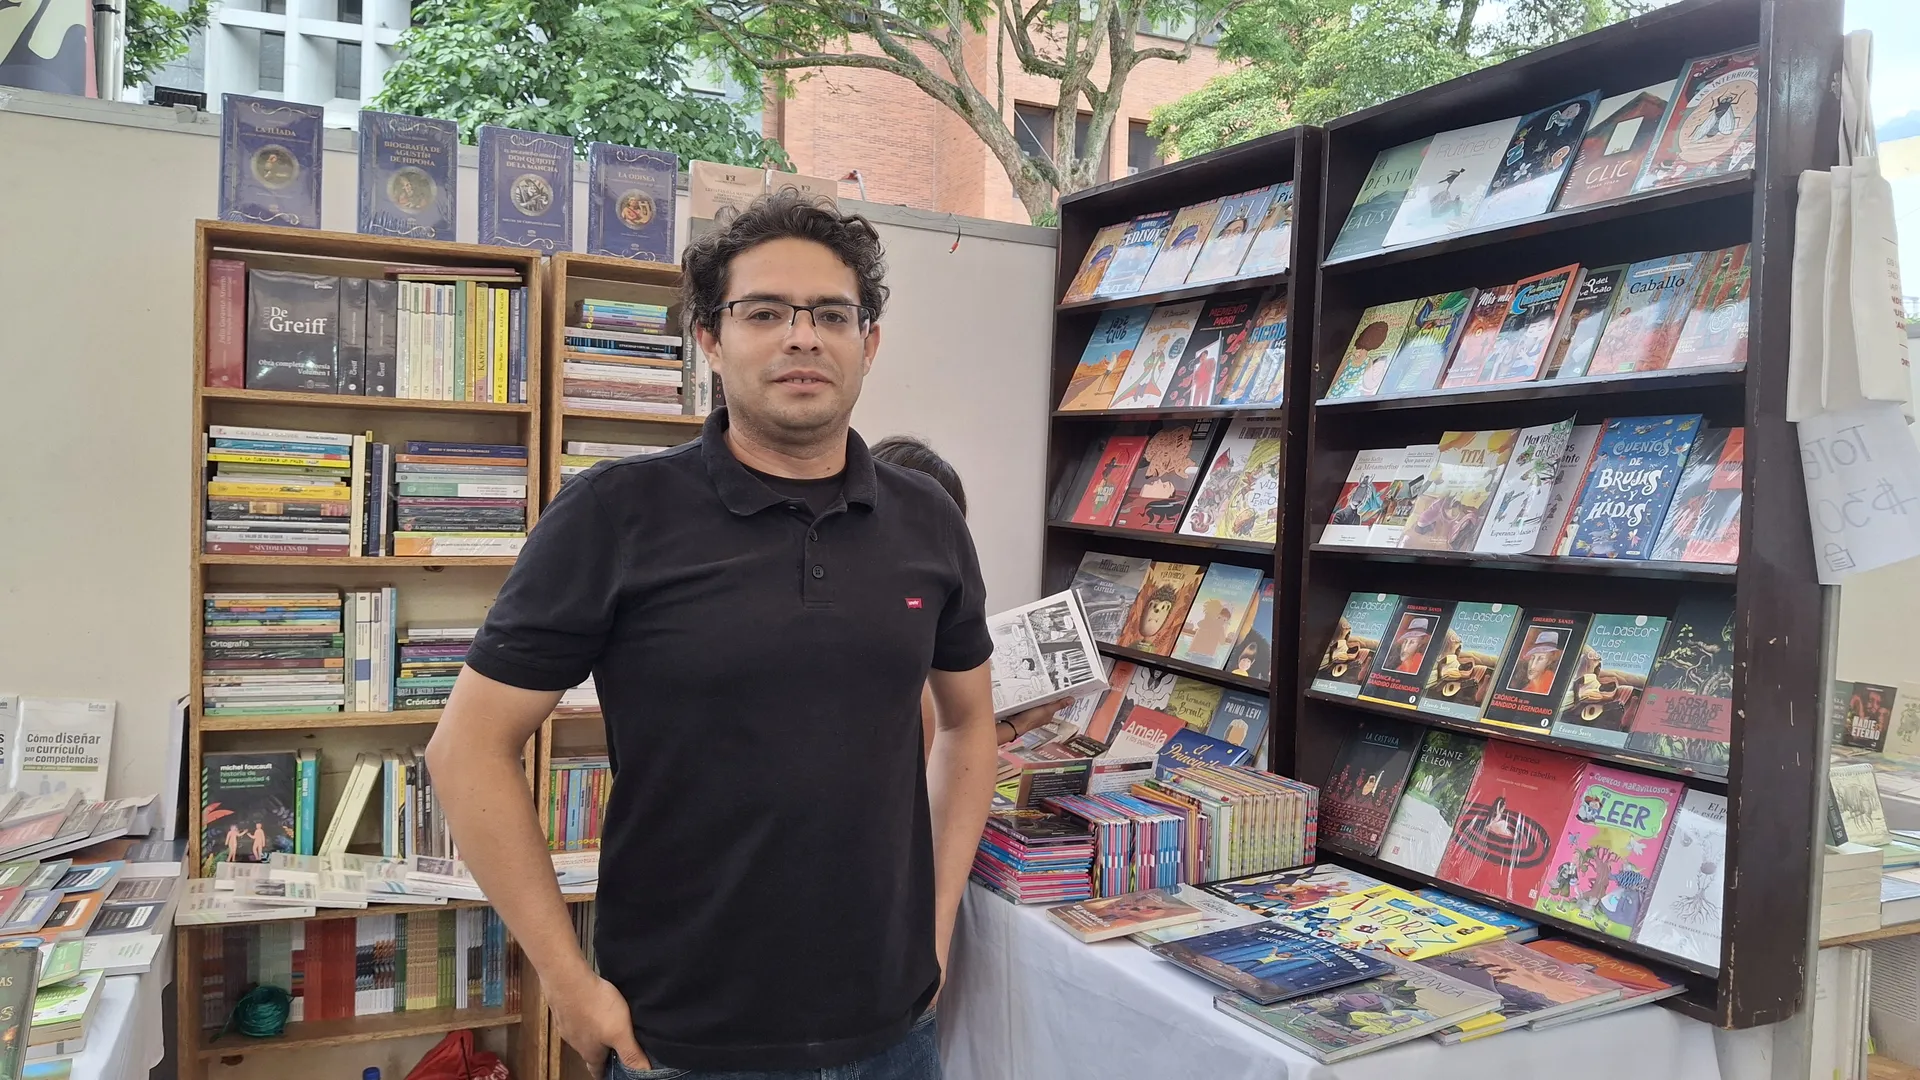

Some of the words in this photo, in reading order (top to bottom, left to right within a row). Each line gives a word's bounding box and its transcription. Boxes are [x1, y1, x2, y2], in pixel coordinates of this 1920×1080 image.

[384, 141, 429, 152] BIOGRAFÍA
[390, 155, 402, 163] DE
[394, 148, 431, 159] AGUSTÍN
[508, 154, 524, 163] DON
[525, 156, 556, 166] QUIJOTE
[526, 163, 558, 173] MANCHA
[628, 173, 656, 183] ODISEA
[1364, 166, 1418, 192] DESTIN
[1344, 208, 1397, 231] FAUST
[1125, 228, 1162, 244] EDISON
[1593, 286, 1612, 294] Gato
[1630, 276, 1685, 295] Caballo
[270, 306, 288, 318] De
[1209, 303, 1248, 317] MEMENTO
[269, 316, 328, 335] Greiff
[1213, 315, 1236, 326] MORI
[258, 359, 275, 367] Obra
[297, 368, 324, 377] Volumen
[1612, 437, 1676, 456] CUENTOS
[1628, 456, 1643, 467] DE
[1260, 479, 1279, 490] VID
[1599, 465, 1668, 495] BRUJAS
[1629, 489, 1639, 501] Y
[1585, 502, 1651, 527] HADAS
[1099, 558, 1130, 573] Huracán
[211, 640, 250, 648] Ortografía
[1370, 672, 1391, 681] CRÓNICA
[1368, 679, 1389, 689] BANDIDO
[1390, 682, 1420, 693] LEGENDARIO
[406, 698, 440, 706] Crónicas
[1494, 693, 1518, 702] CRÓNICA
[1678, 696, 1708, 709] COSA
[1224, 701, 1243, 716] PRIMO
[1246, 705, 1262, 719] LEVI
[1424, 700, 1439, 709] Eduardo
[1491, 700, 1516, 710] BANDIDO
[1517, 704, 1552, 716] LEGENDARIO
[1667, 703, 1717, 719] PANTANO
[1852, 715, 1876, 728] NADIE
[1126, 721, 1168, 744] Amelia
[1558, 726, 1577, 735] Eduardo
[1578, 727, 1592, 738] Santa
[1851, 727, 1880, 741] ETERNO
[27, 733, 54, 743] Cómo
[55, 732, 101, 745] diseñar
[1130, 735, 1138, 743] los
[1365, 732, 1373, 741] LA
[1374, 733, 1400, 746] COSTURA
[36, 744, 85, 755] currículo
[1193, 744, 1213, 756] El
[1421, 744, 1463, 761] CANTANTE
[35, 754, 99, 765] competencias
[1421, 754, 1429, 763] EL
[1430, 755, 1452, 769] LEÓN
[1505, 751, 1513, 759] La
[1514, 754, 1540, 765] princesa
[1510, 765, 1529, 776] largos
[1530, 769, 1555, 781] cabellos
[227, 776, 264, 784] sexualidad
[1708, 802, 1719, 811] El
[1595, 797, 1650, 830] LEER
[1702, 811, 1725, 821] estar
[1258, 936, 1287, 946] ENTRE
[1260, 927, 1317, 943] SANTIAGO
